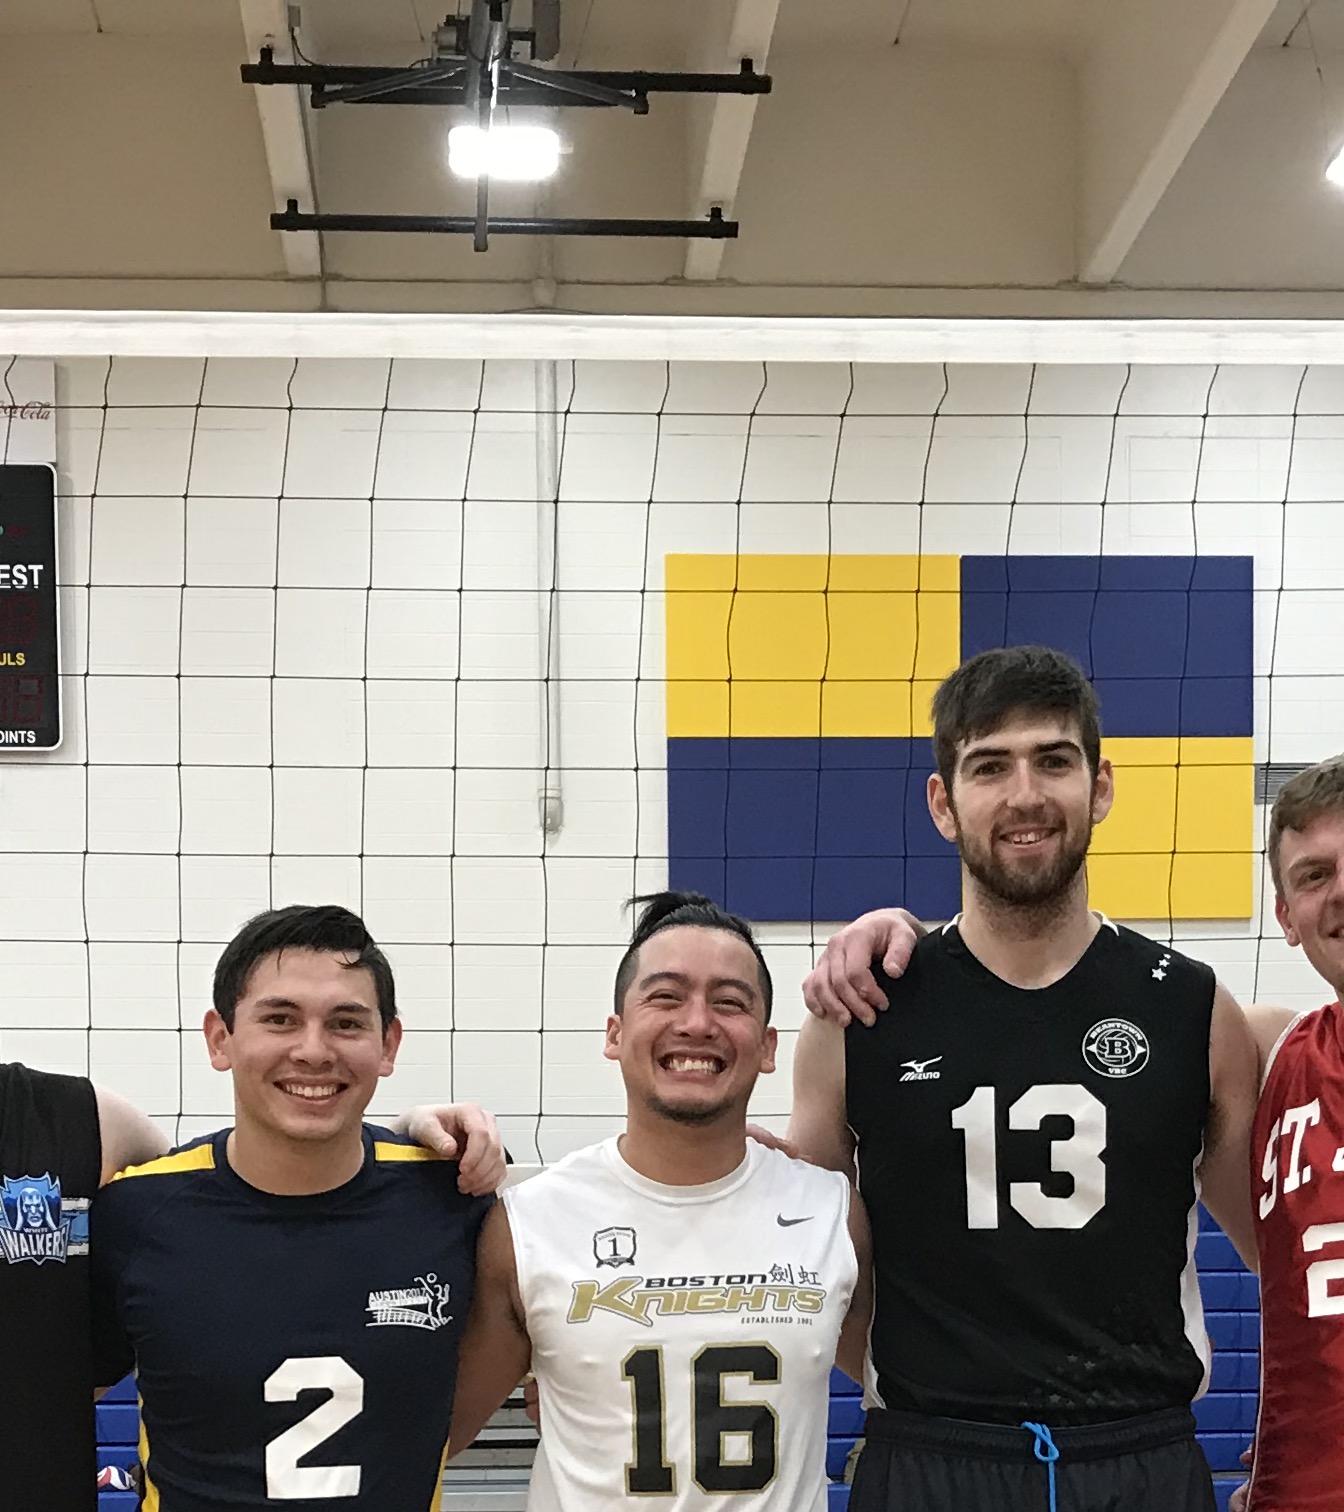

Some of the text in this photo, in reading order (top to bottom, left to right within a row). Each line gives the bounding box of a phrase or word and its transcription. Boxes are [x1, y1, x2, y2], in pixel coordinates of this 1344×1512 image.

[951, 1084, 1106, 1229] 13
[1259, 1098, 1320, 1221] ST.
[567, 1276, 827, 1327] KNIGHTS
[607, 1237, 622, 1257] 1
[645, 1274, 767, 1289] BOSTON
[264, 1356, 364, 1499] 2
[621, 1340, 783, 1497] 16
